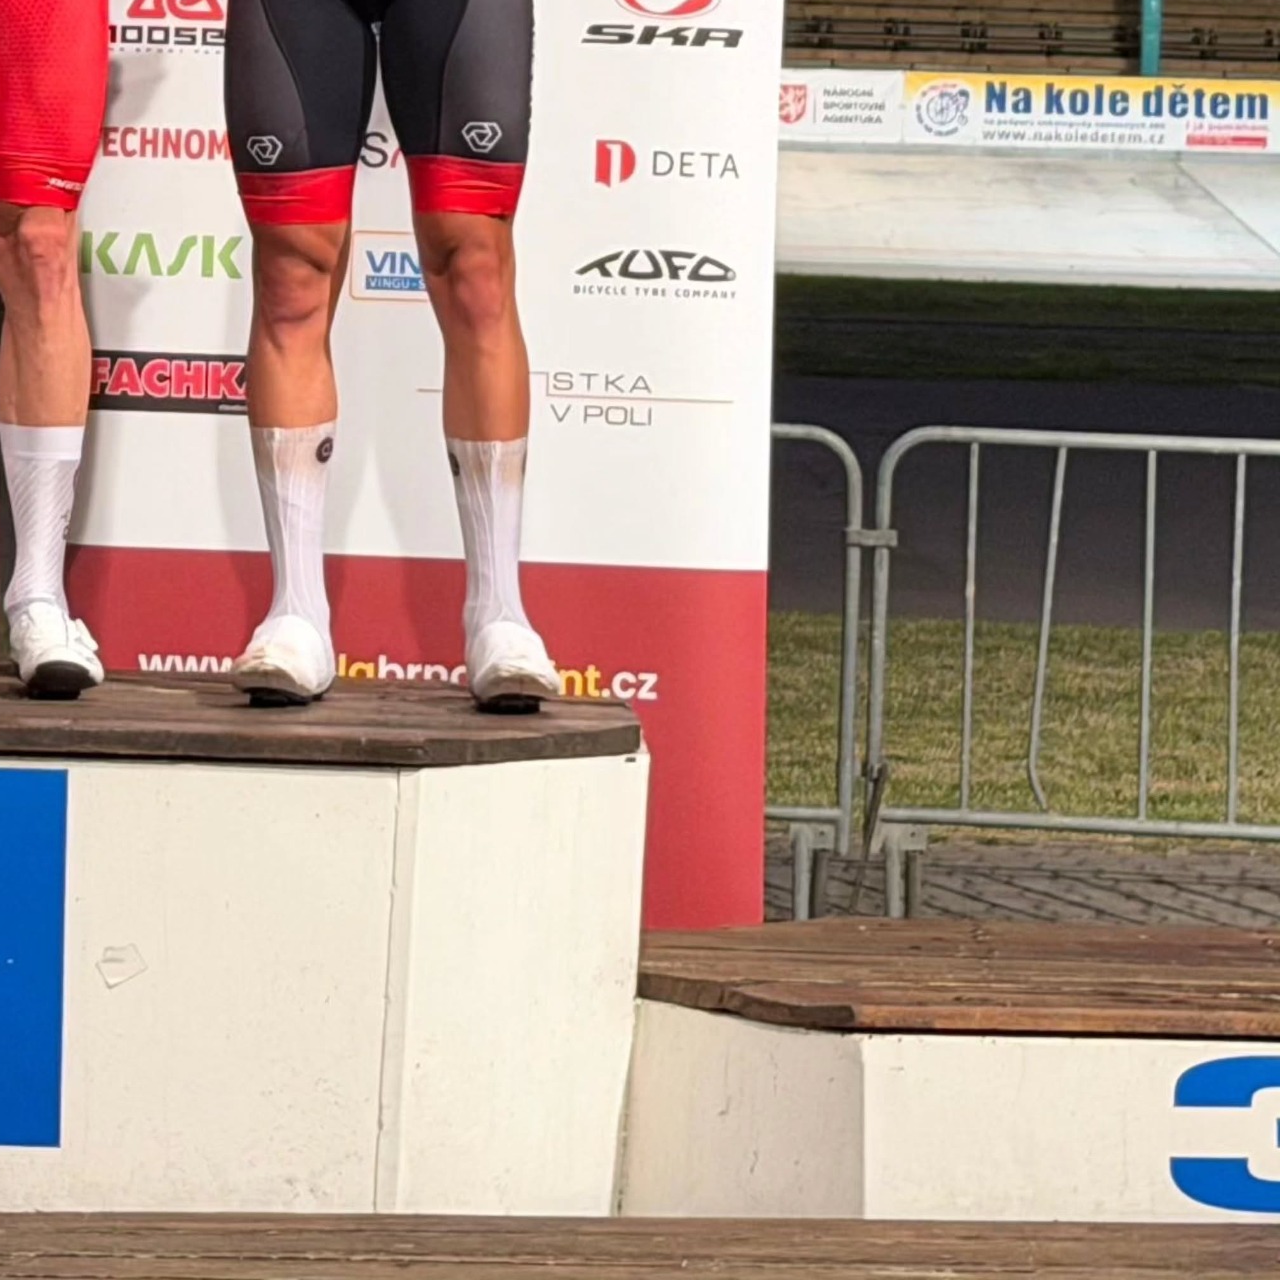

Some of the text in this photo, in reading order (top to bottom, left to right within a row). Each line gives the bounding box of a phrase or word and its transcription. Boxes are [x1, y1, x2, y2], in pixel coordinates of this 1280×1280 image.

[581, 24, 743, 48] SKA
[985, 81, 1032, 113] Na
[1045, 83, 1130, 116] kole
[1142, 84, 1269, 119] dětem
[102, 127, 231, 160] ECHNOM
[652, 151, 739, 179] DETA
[82, 232, 242, 279] KASK
[575, 249, 736, 282] TUFO
[573, 284, 627, 296] BICYCLE
[674, 288, 737, 299] COMPANY
[91, 358, 247, 400] FACHK
[551, 404, 652, 426] V POLI
